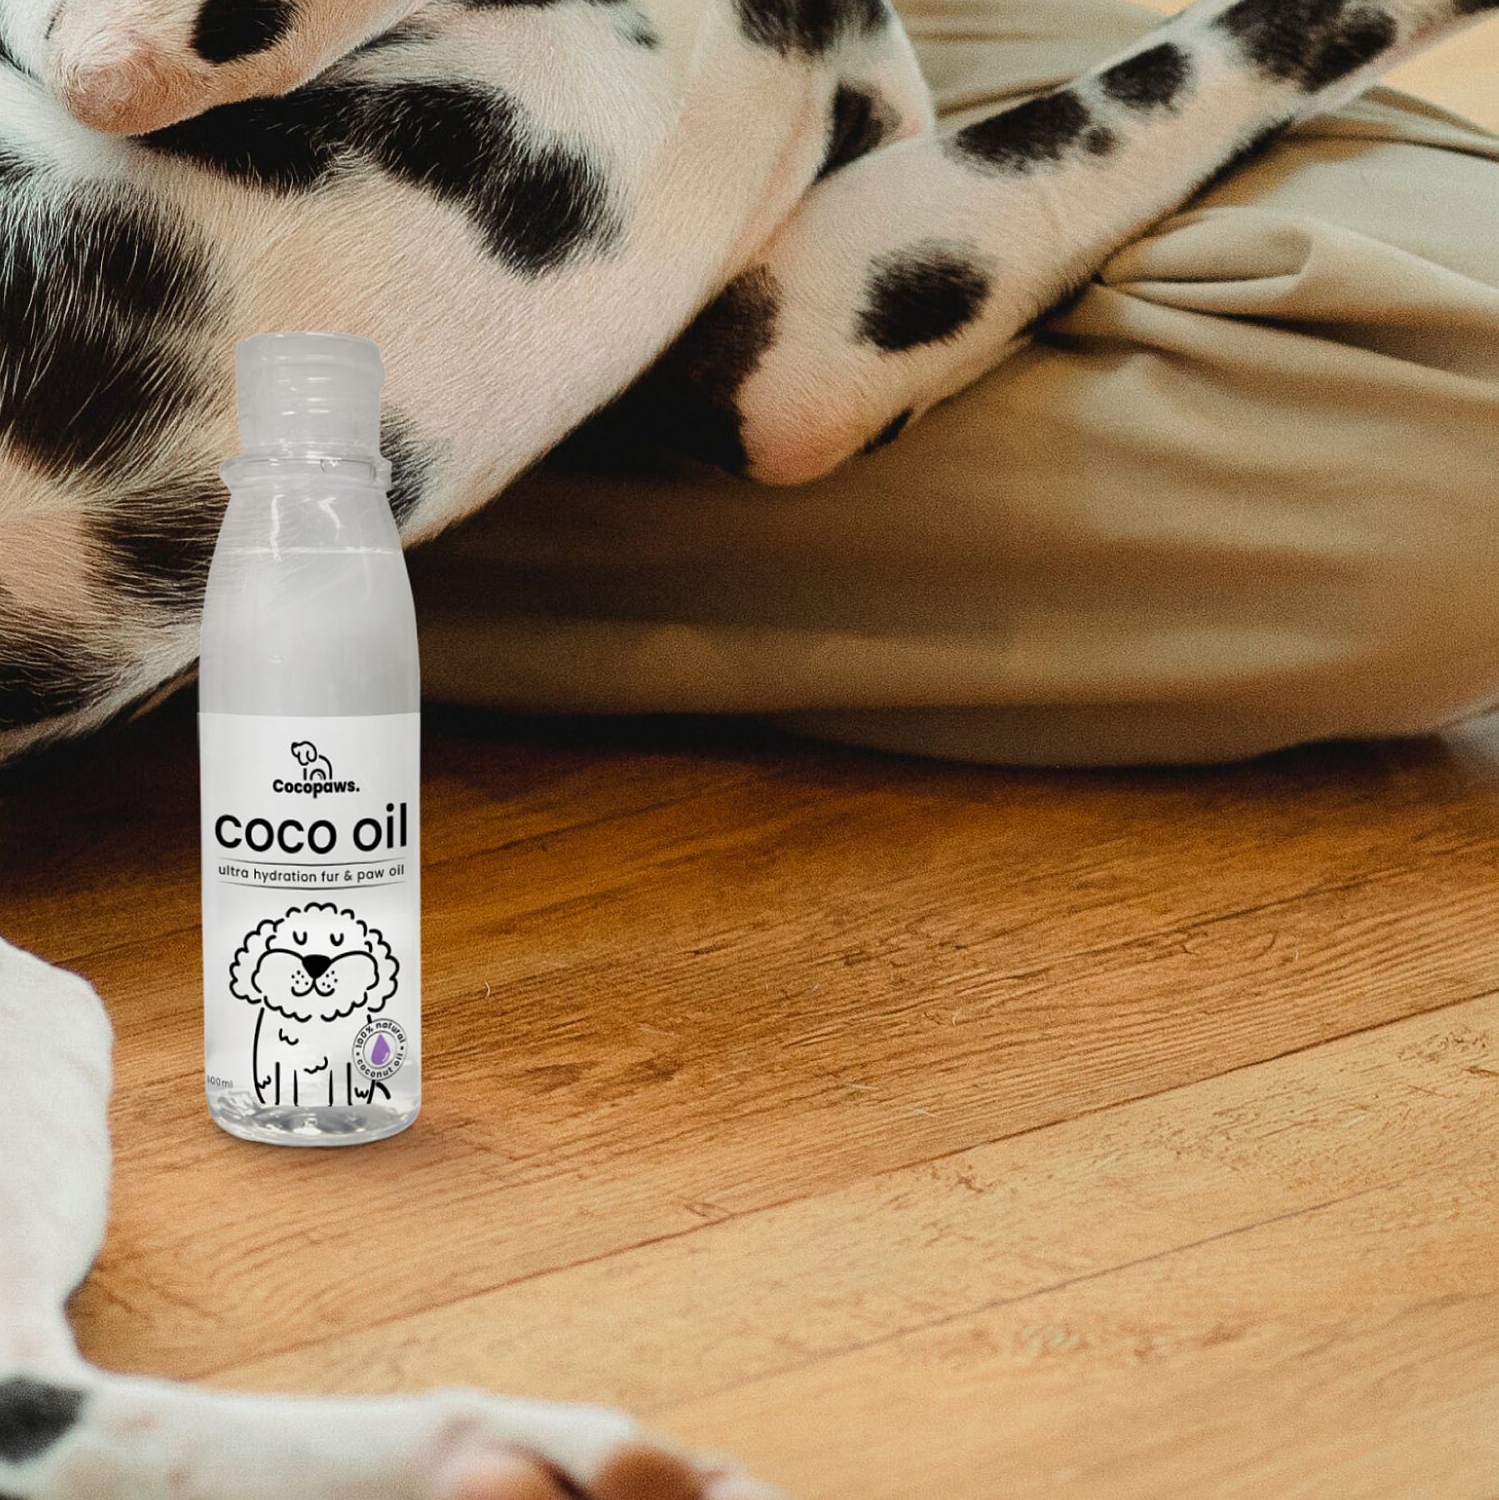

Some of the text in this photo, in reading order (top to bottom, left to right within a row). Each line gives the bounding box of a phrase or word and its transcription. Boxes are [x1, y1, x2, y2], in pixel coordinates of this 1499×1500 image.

[272, 779, 360, 799] Cocopaws.
[215, 802, 407, 854] coco oil
[218, 864, 405, 883] ultra hydration fur & paw oil
[355, 1022, 406, 1049] 100% natural
[357, 1053, 404, 1078] coconut oil
